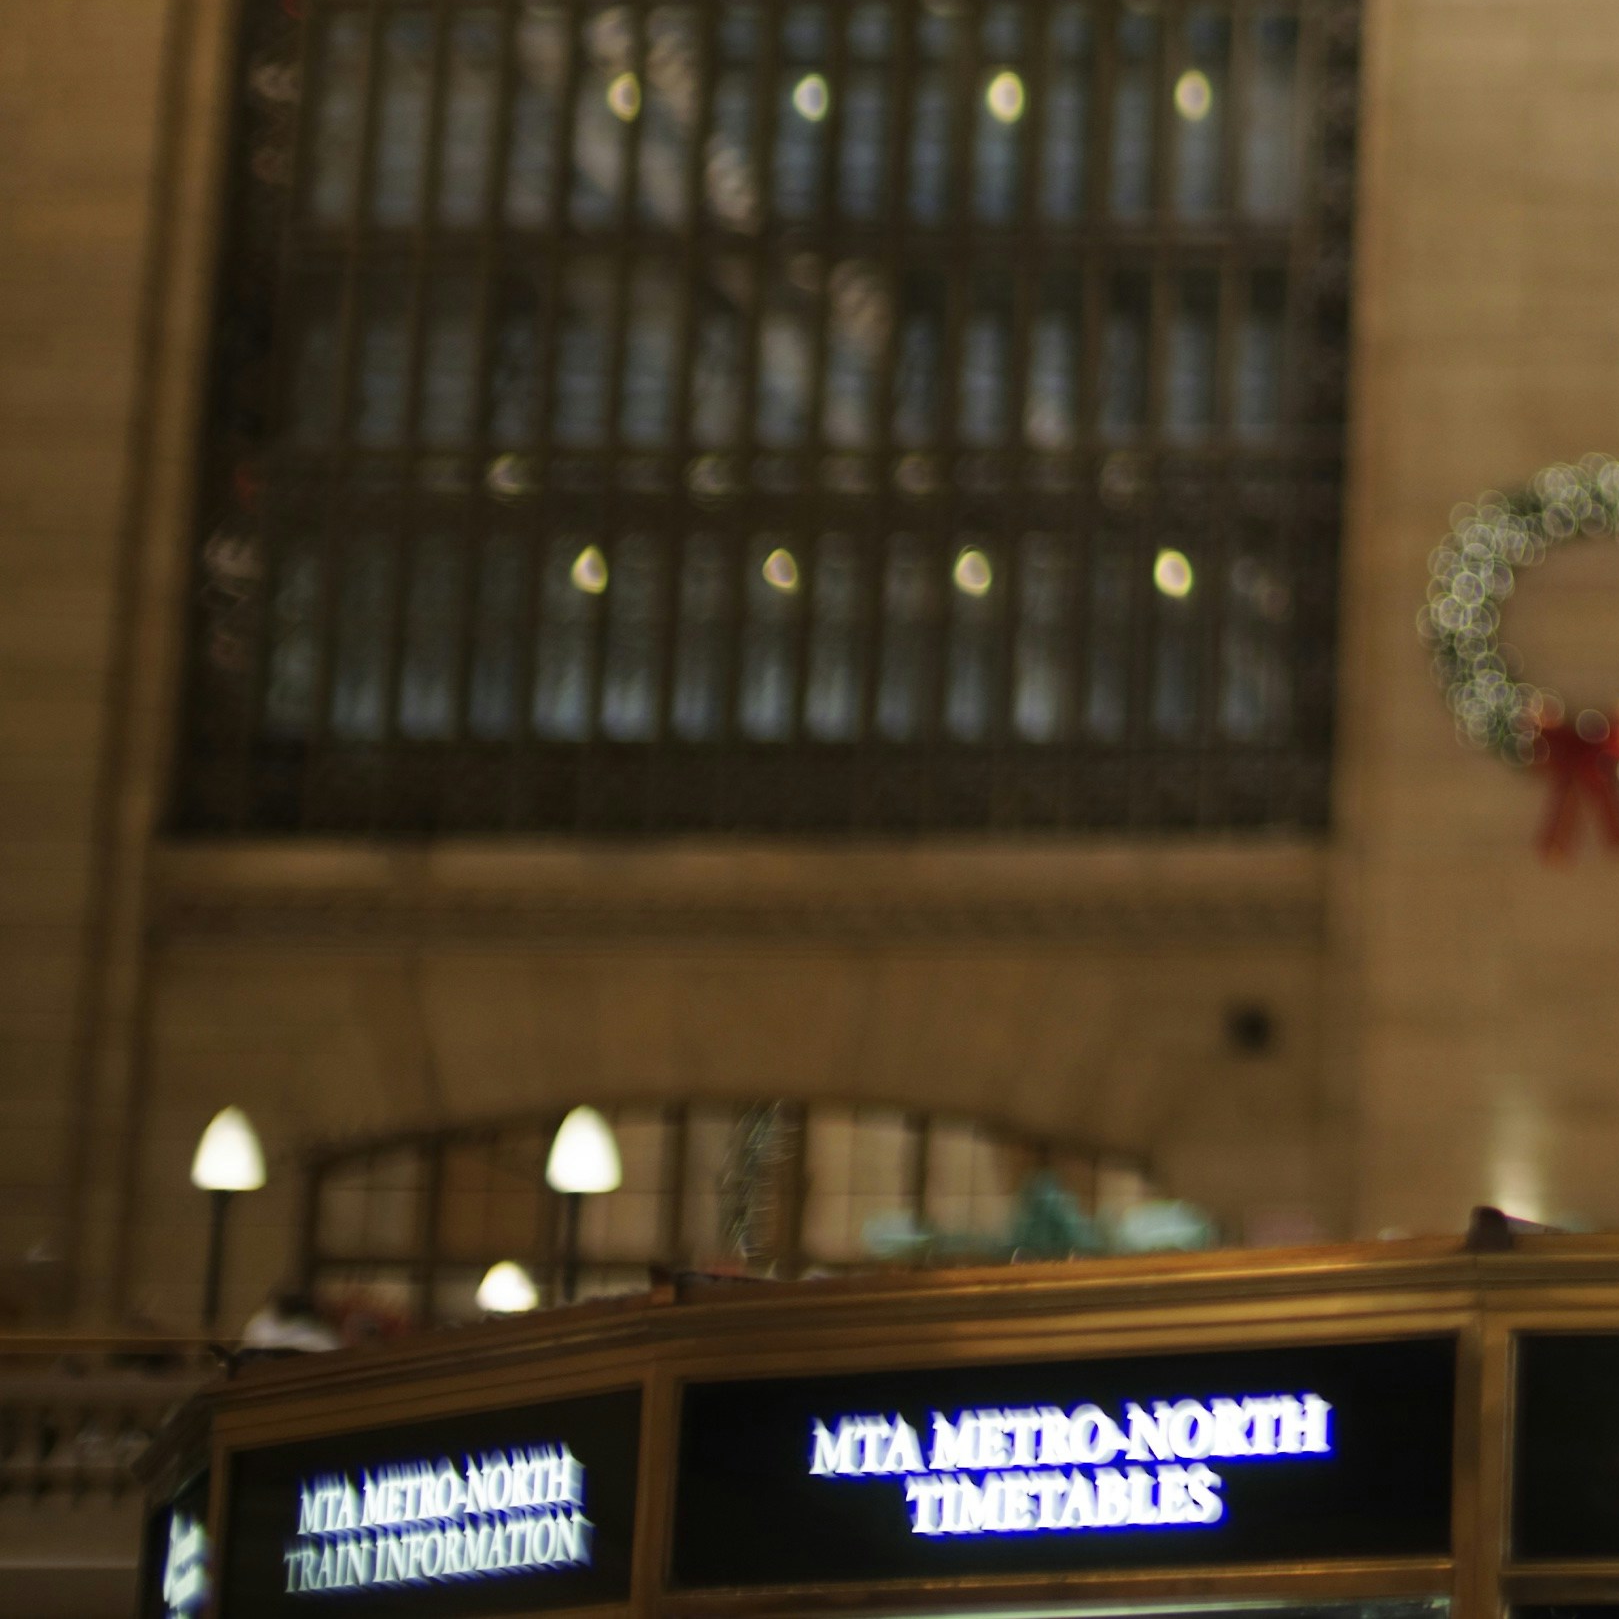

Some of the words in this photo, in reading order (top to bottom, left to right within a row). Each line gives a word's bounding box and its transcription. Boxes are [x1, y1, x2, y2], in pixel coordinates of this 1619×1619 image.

[808, 1413, 925, 1477] MTA
[928, 1393, 1331, 1471] METRO-NORTH
[296, 1477, 360, 1536] MTA
[360, 1446, 584, 1527] METRO-NORTH
[905, 1465, 1224, 1537] TIMETABLES
[284, 1534, 374, 1593] TRAIN
[372, 1512, 592, 1585] INFORMATION
